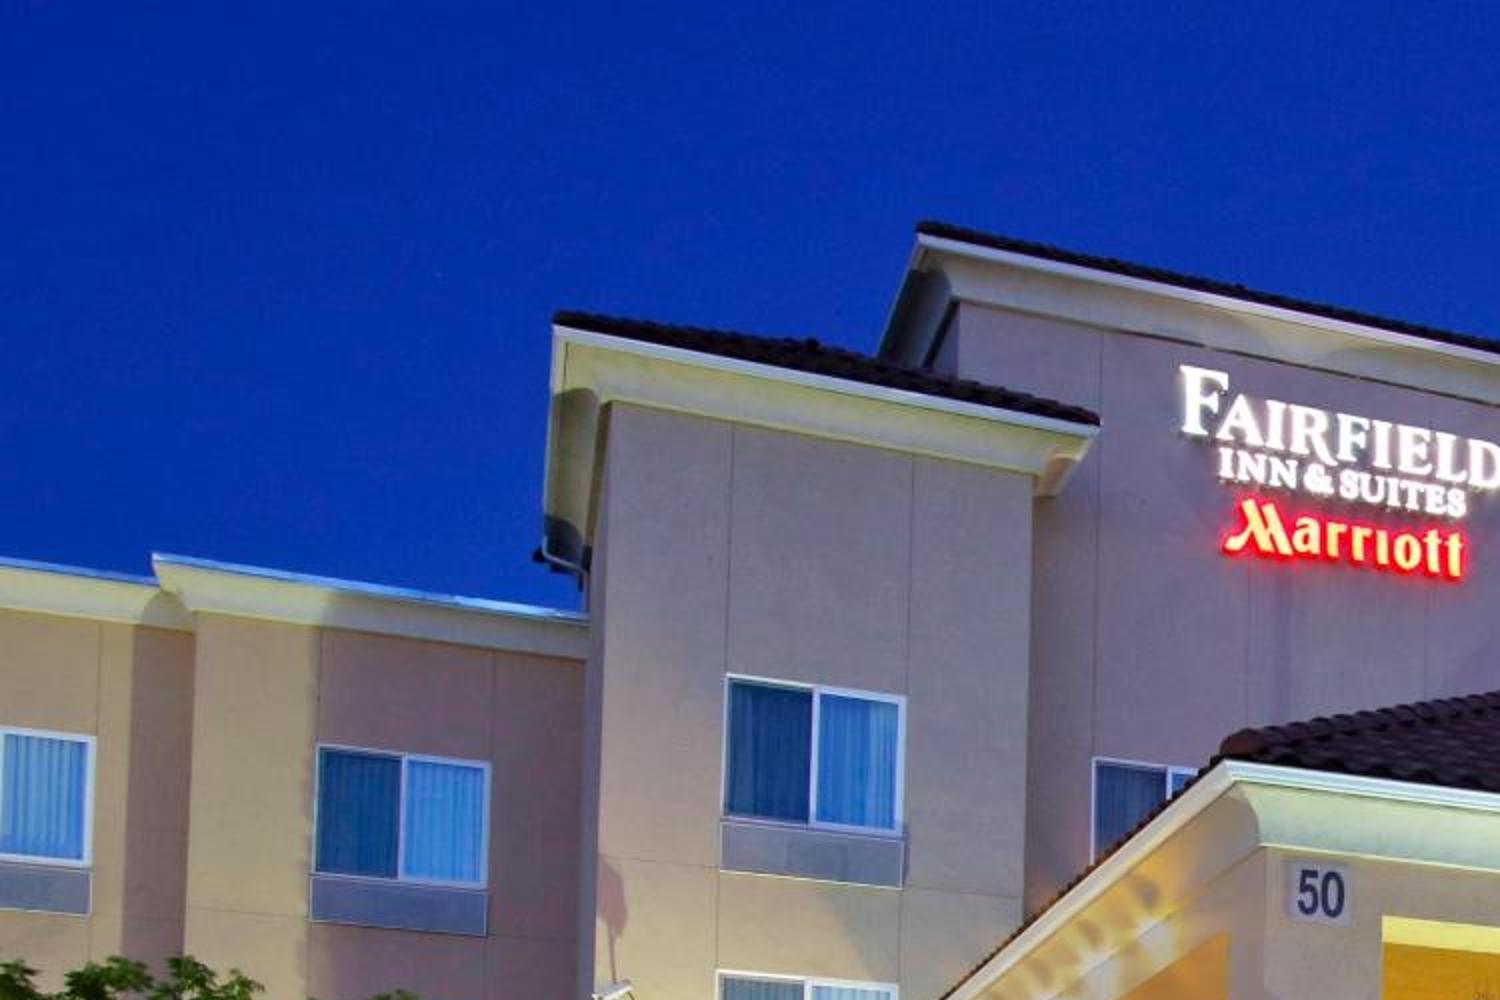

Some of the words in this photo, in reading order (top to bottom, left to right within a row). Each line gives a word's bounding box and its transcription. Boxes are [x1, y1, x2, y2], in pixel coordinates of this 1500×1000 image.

[1219, 448, 1298, 489] INN
[1304, 464, 1334, 496] &
[1340, 468, 1468, 518] SUITES
[1224, 498, 1463, 578] Marriott
[1297, 868, 1344, 918] 50
